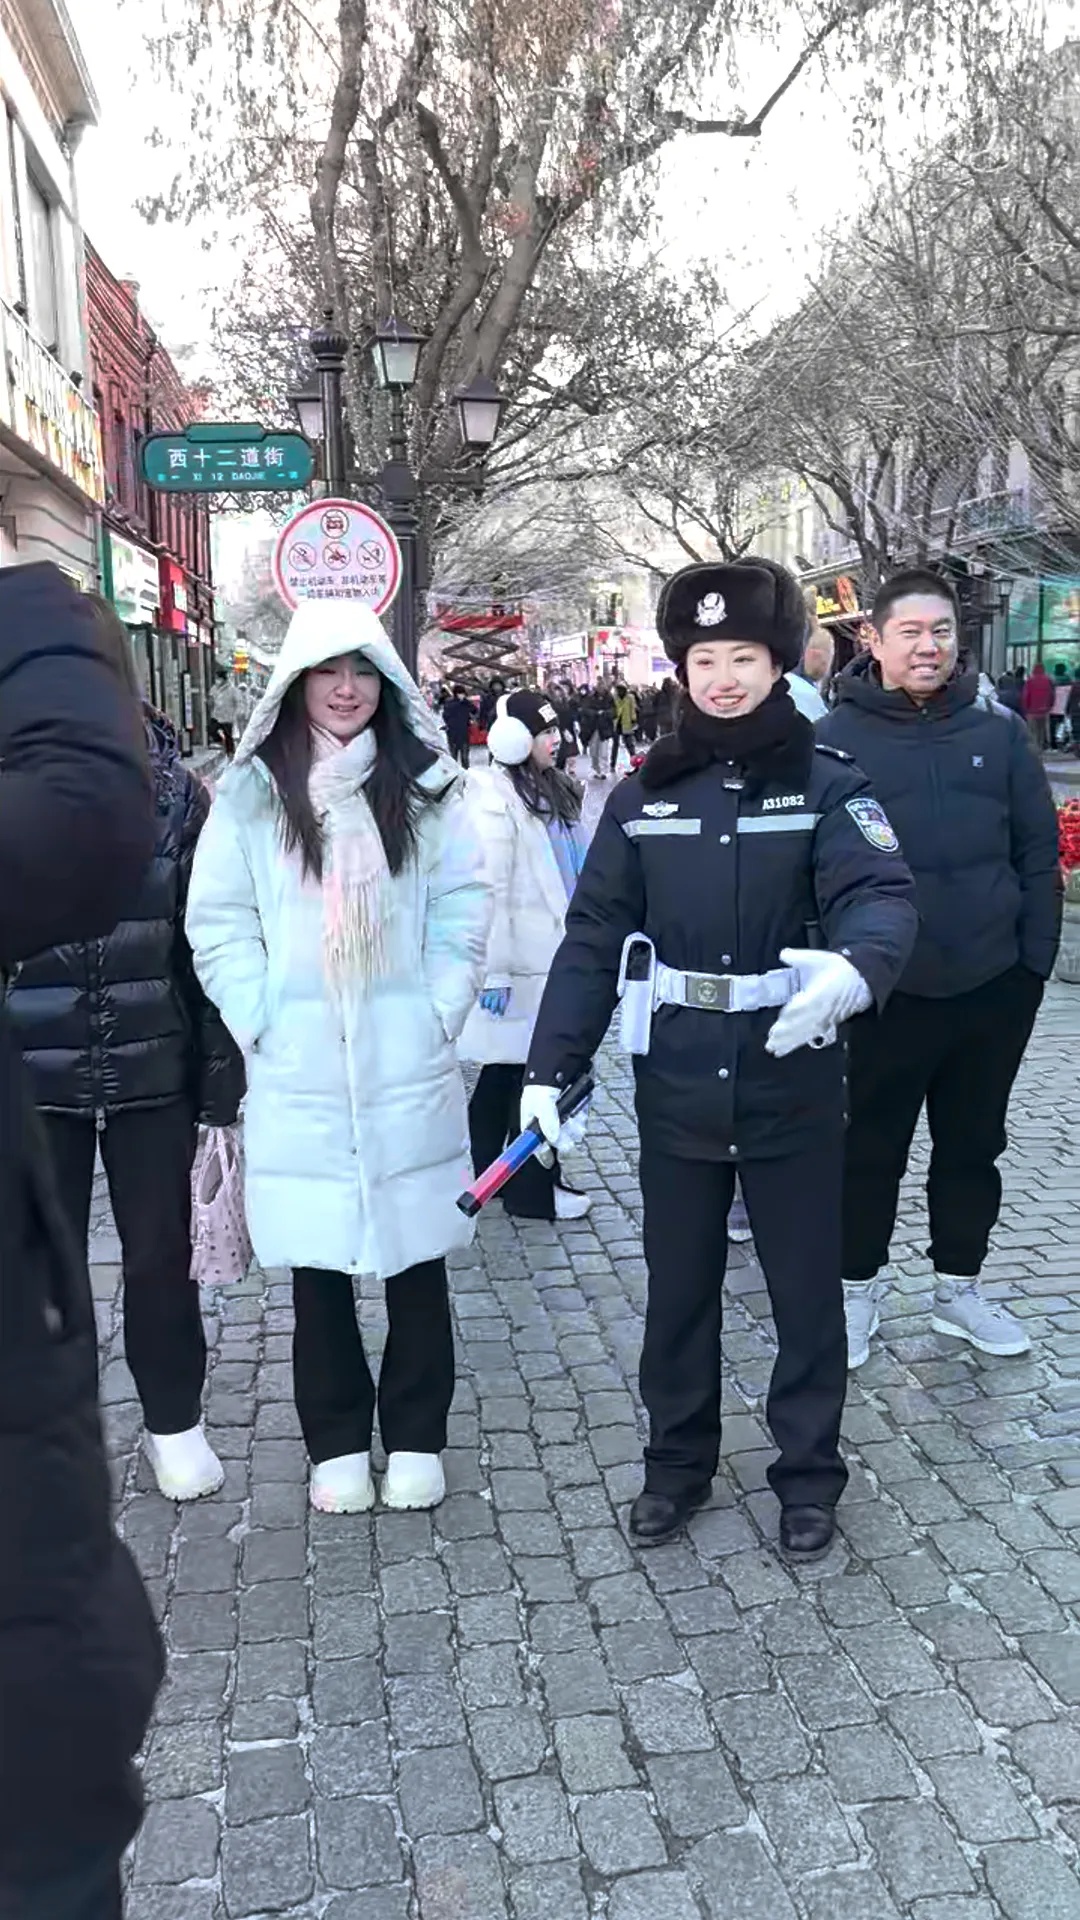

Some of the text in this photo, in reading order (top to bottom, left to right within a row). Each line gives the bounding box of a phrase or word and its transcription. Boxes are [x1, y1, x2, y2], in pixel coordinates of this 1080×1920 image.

[167, 447, 285, 468] 西十二道街
[211, 472, 224, 480] 12
[231, 471, 266, 480] DAOJIE
[762, 795, 805, 809] A31082
